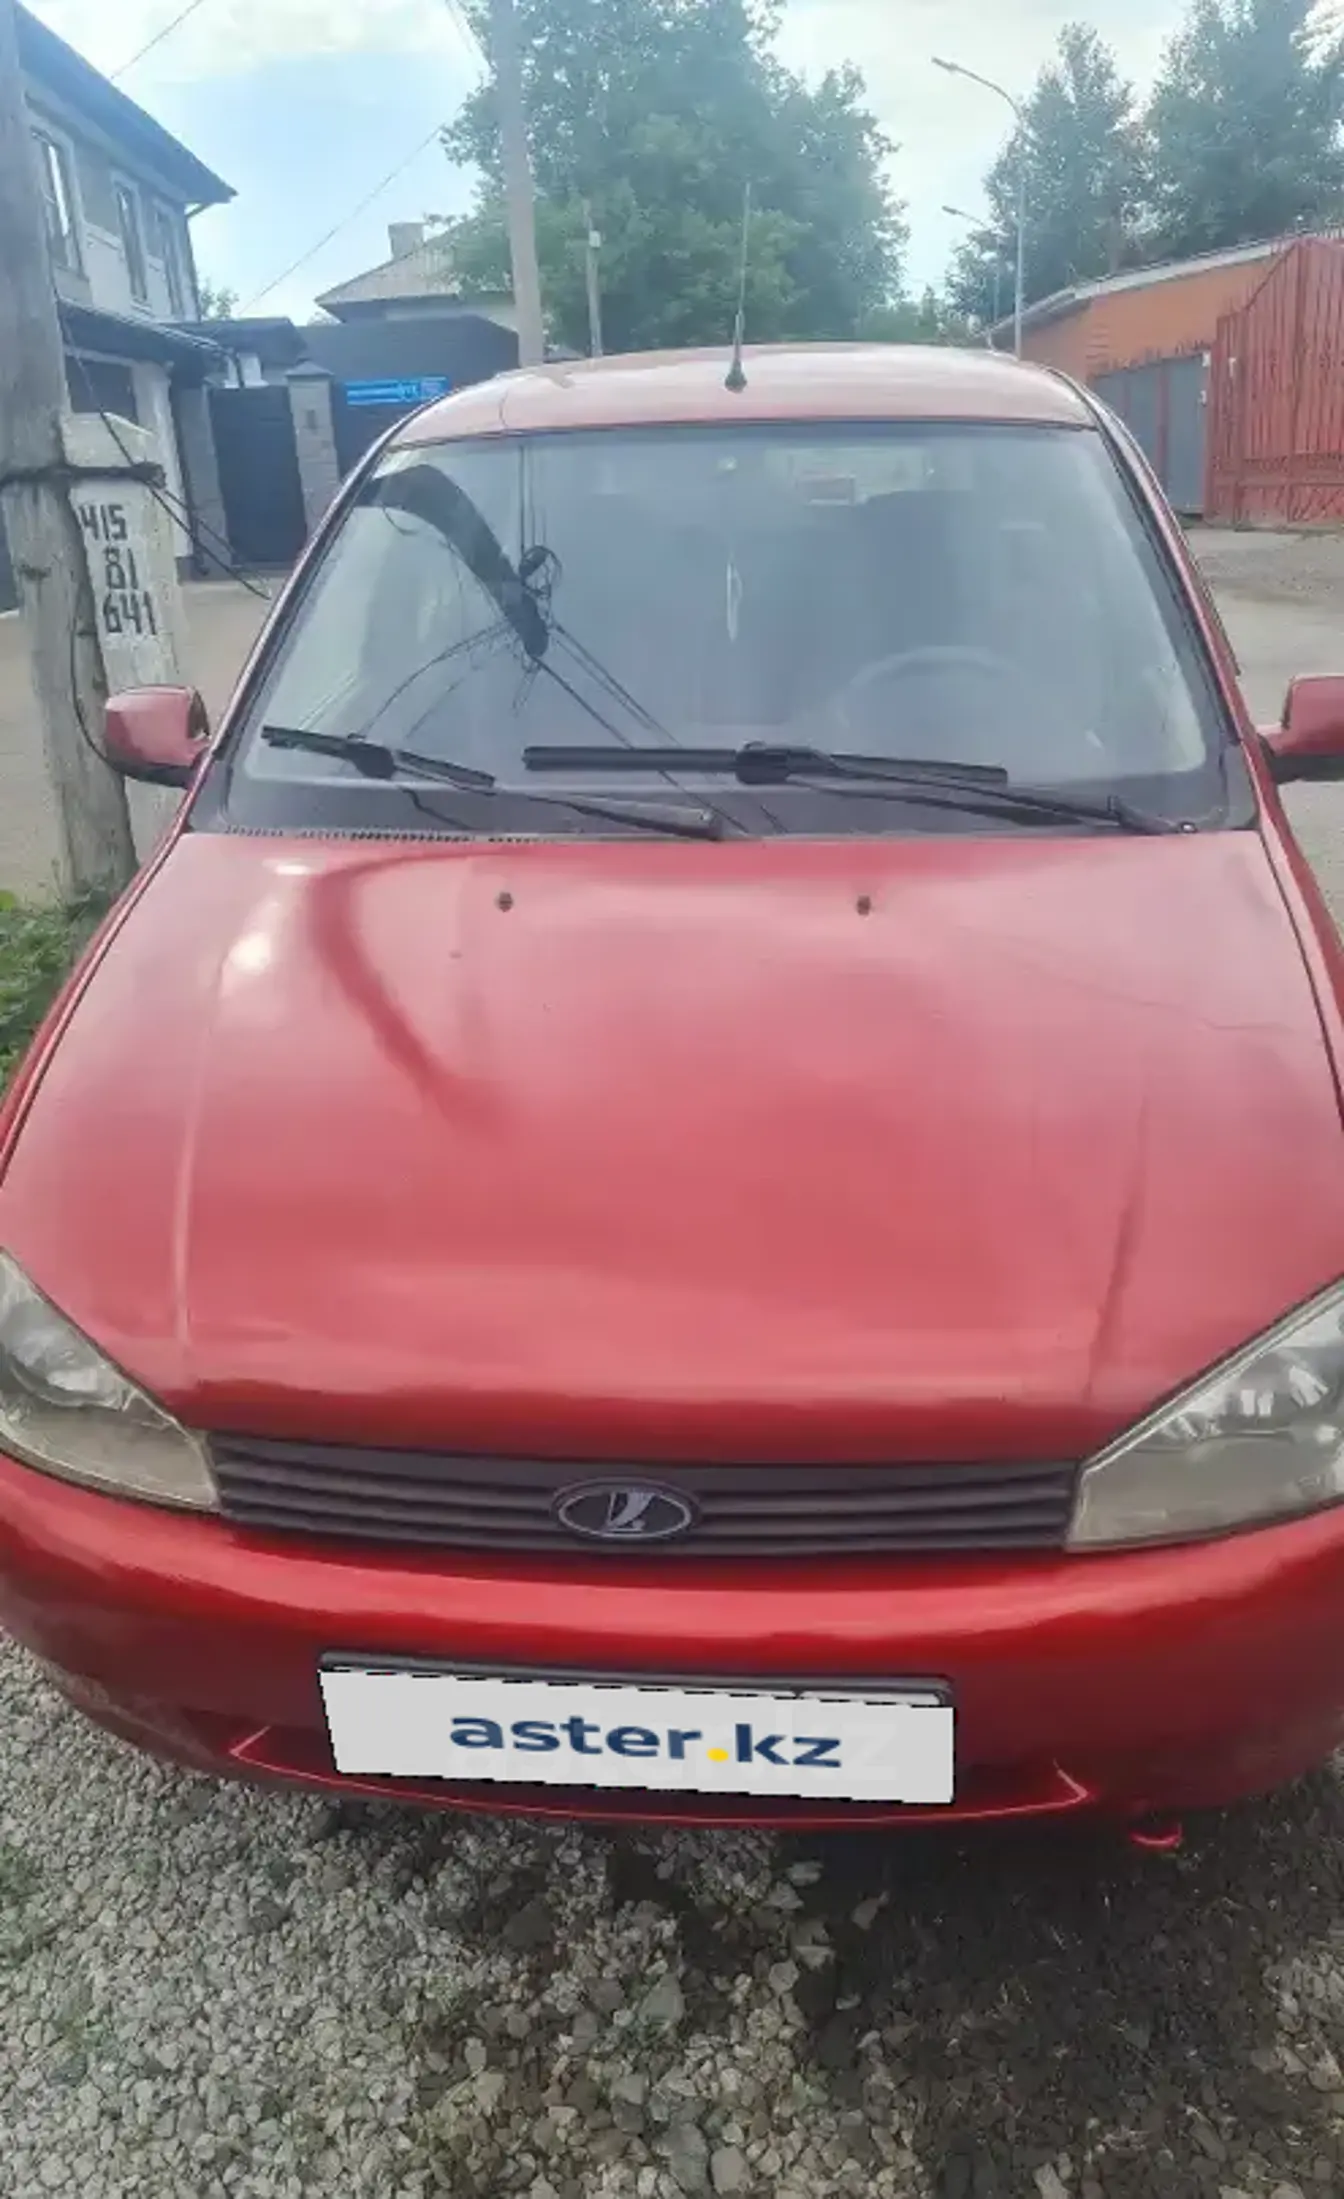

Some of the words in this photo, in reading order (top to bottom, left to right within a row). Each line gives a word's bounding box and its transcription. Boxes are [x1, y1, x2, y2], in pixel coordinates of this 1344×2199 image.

[79, 504, 128, 541] 415
[103, 546, 139, 590] 81
[102, 591, 157, 636] 641
